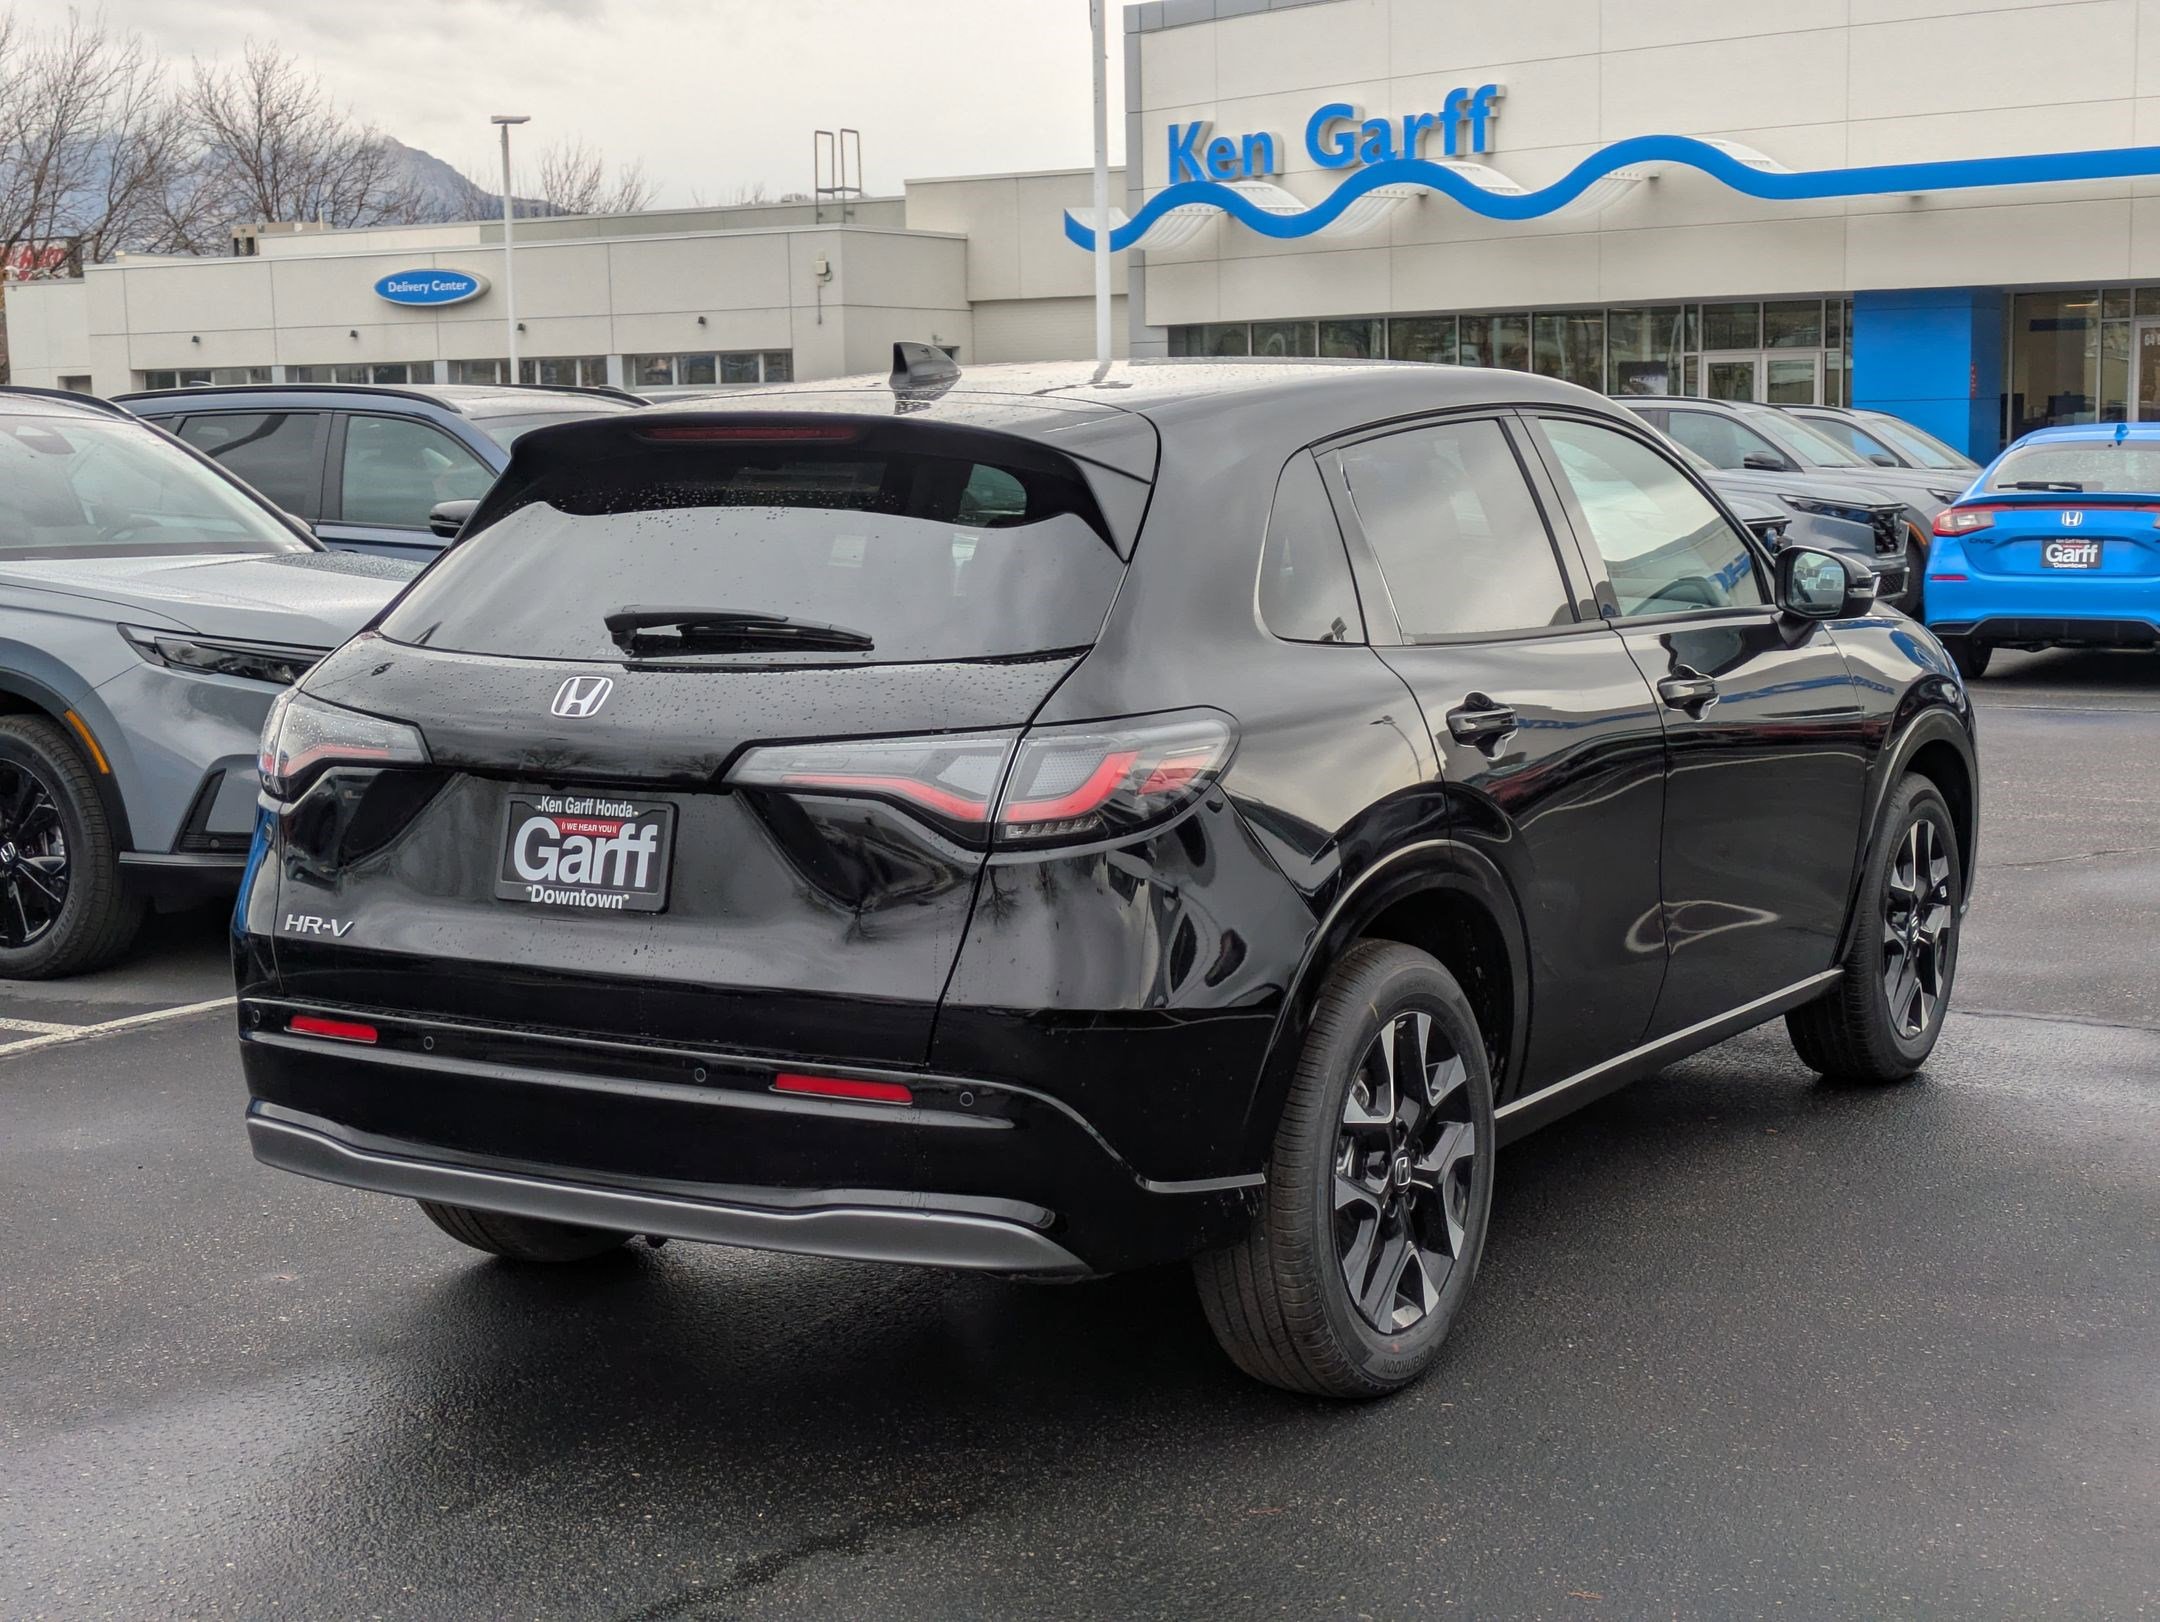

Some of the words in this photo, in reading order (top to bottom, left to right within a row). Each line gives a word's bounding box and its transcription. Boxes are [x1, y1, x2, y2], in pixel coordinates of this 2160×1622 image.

[1168, 120, 1276, 185] Ken
[1305, 83, 1499, 170] Garff
[387, 281, 430, 295] Delivery
[431, 280, 468, 291] Center
[2045, 543, 2098, 563] Garff
[540, 795, 563, 813] Ken
[565, 796, 594, 815] Garff
[595, 799, 633, 818] Honda
[566, 822, 578, 831] WE
[578, 823, 598, 832] HEAR
[598, 824, 612, 833] YOU
[513, 816, 658, 888] Garff
[530, 884, 624, 910] Downtown
[283, 913, 354, 938] HR-V
